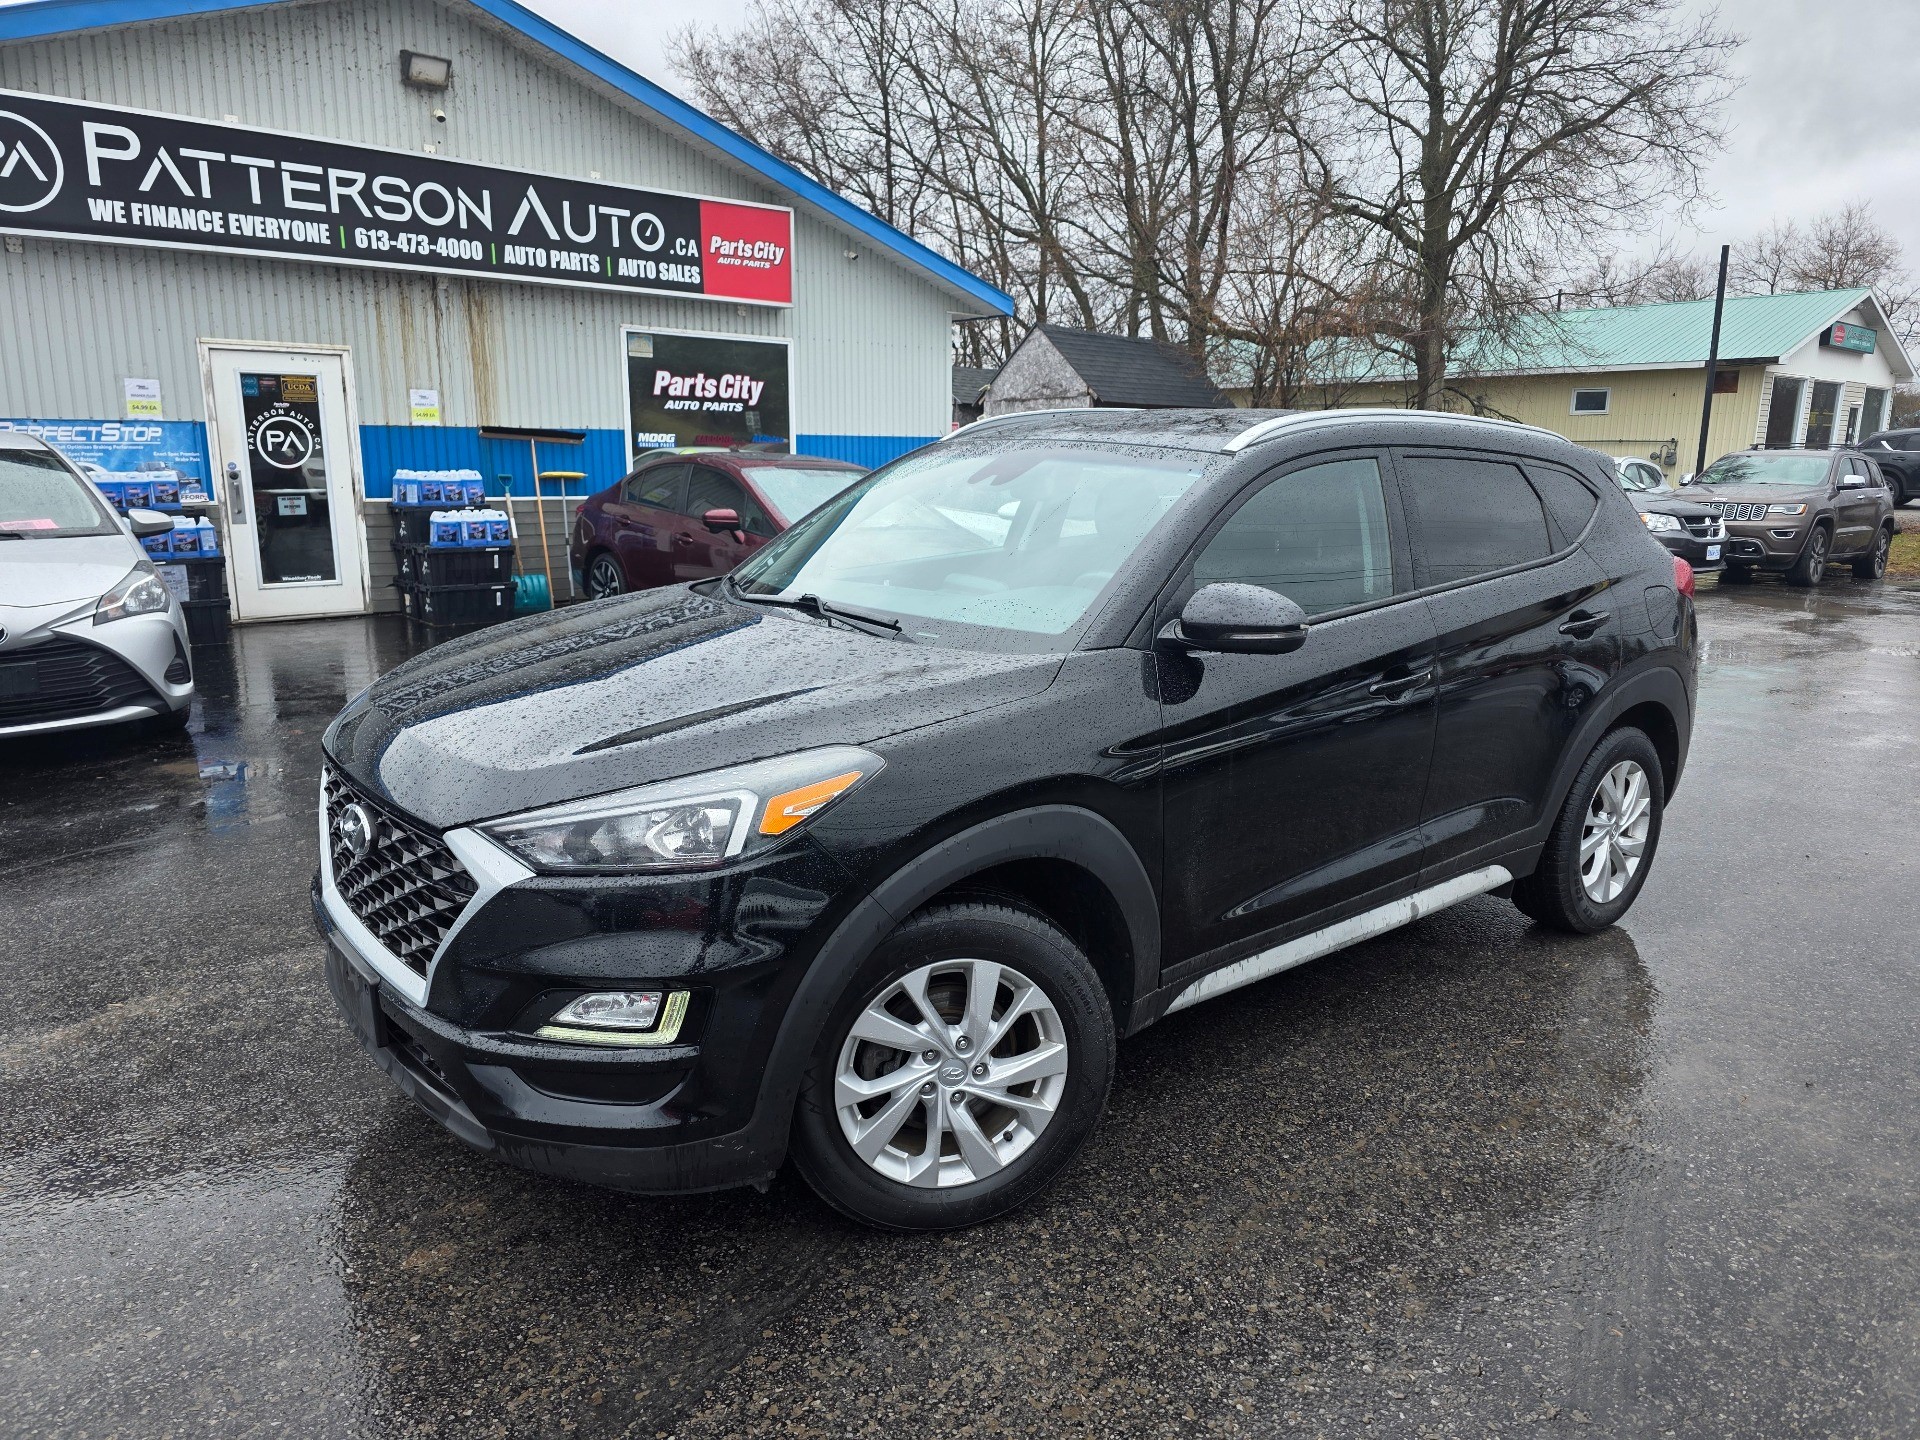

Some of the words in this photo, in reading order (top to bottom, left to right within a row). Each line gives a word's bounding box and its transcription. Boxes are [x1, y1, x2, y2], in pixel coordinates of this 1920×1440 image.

[0, 138, 49, 181] A
[82, 121, 493, 232] PATTERSON
[87, 197, 127, 225] WE
[131, 203, 225, 234] FINANCE
[228, 213, 331, 245] EVERYONE
[354, 227, 483, 261] 613-473-4000
[504, 244, 547, 268] AUTO
[550, 249, 601, 274] PARTS
[618, 257, 657, 280] AUTO
[659, 261, 701, 285] SALES
[717, 256, 742, 266] AUTO
[742, 259, 771, 269] PARTS
[287, 383, 311, 391] UCDA
[664, 400, 700, 411] AUTO
[702, 401, 744, 412] PARTS
[247, 408, 285, 450] PATTERSON
[637, 432, 676, 443] MOOG
[265, 430, 306, 452] PA
